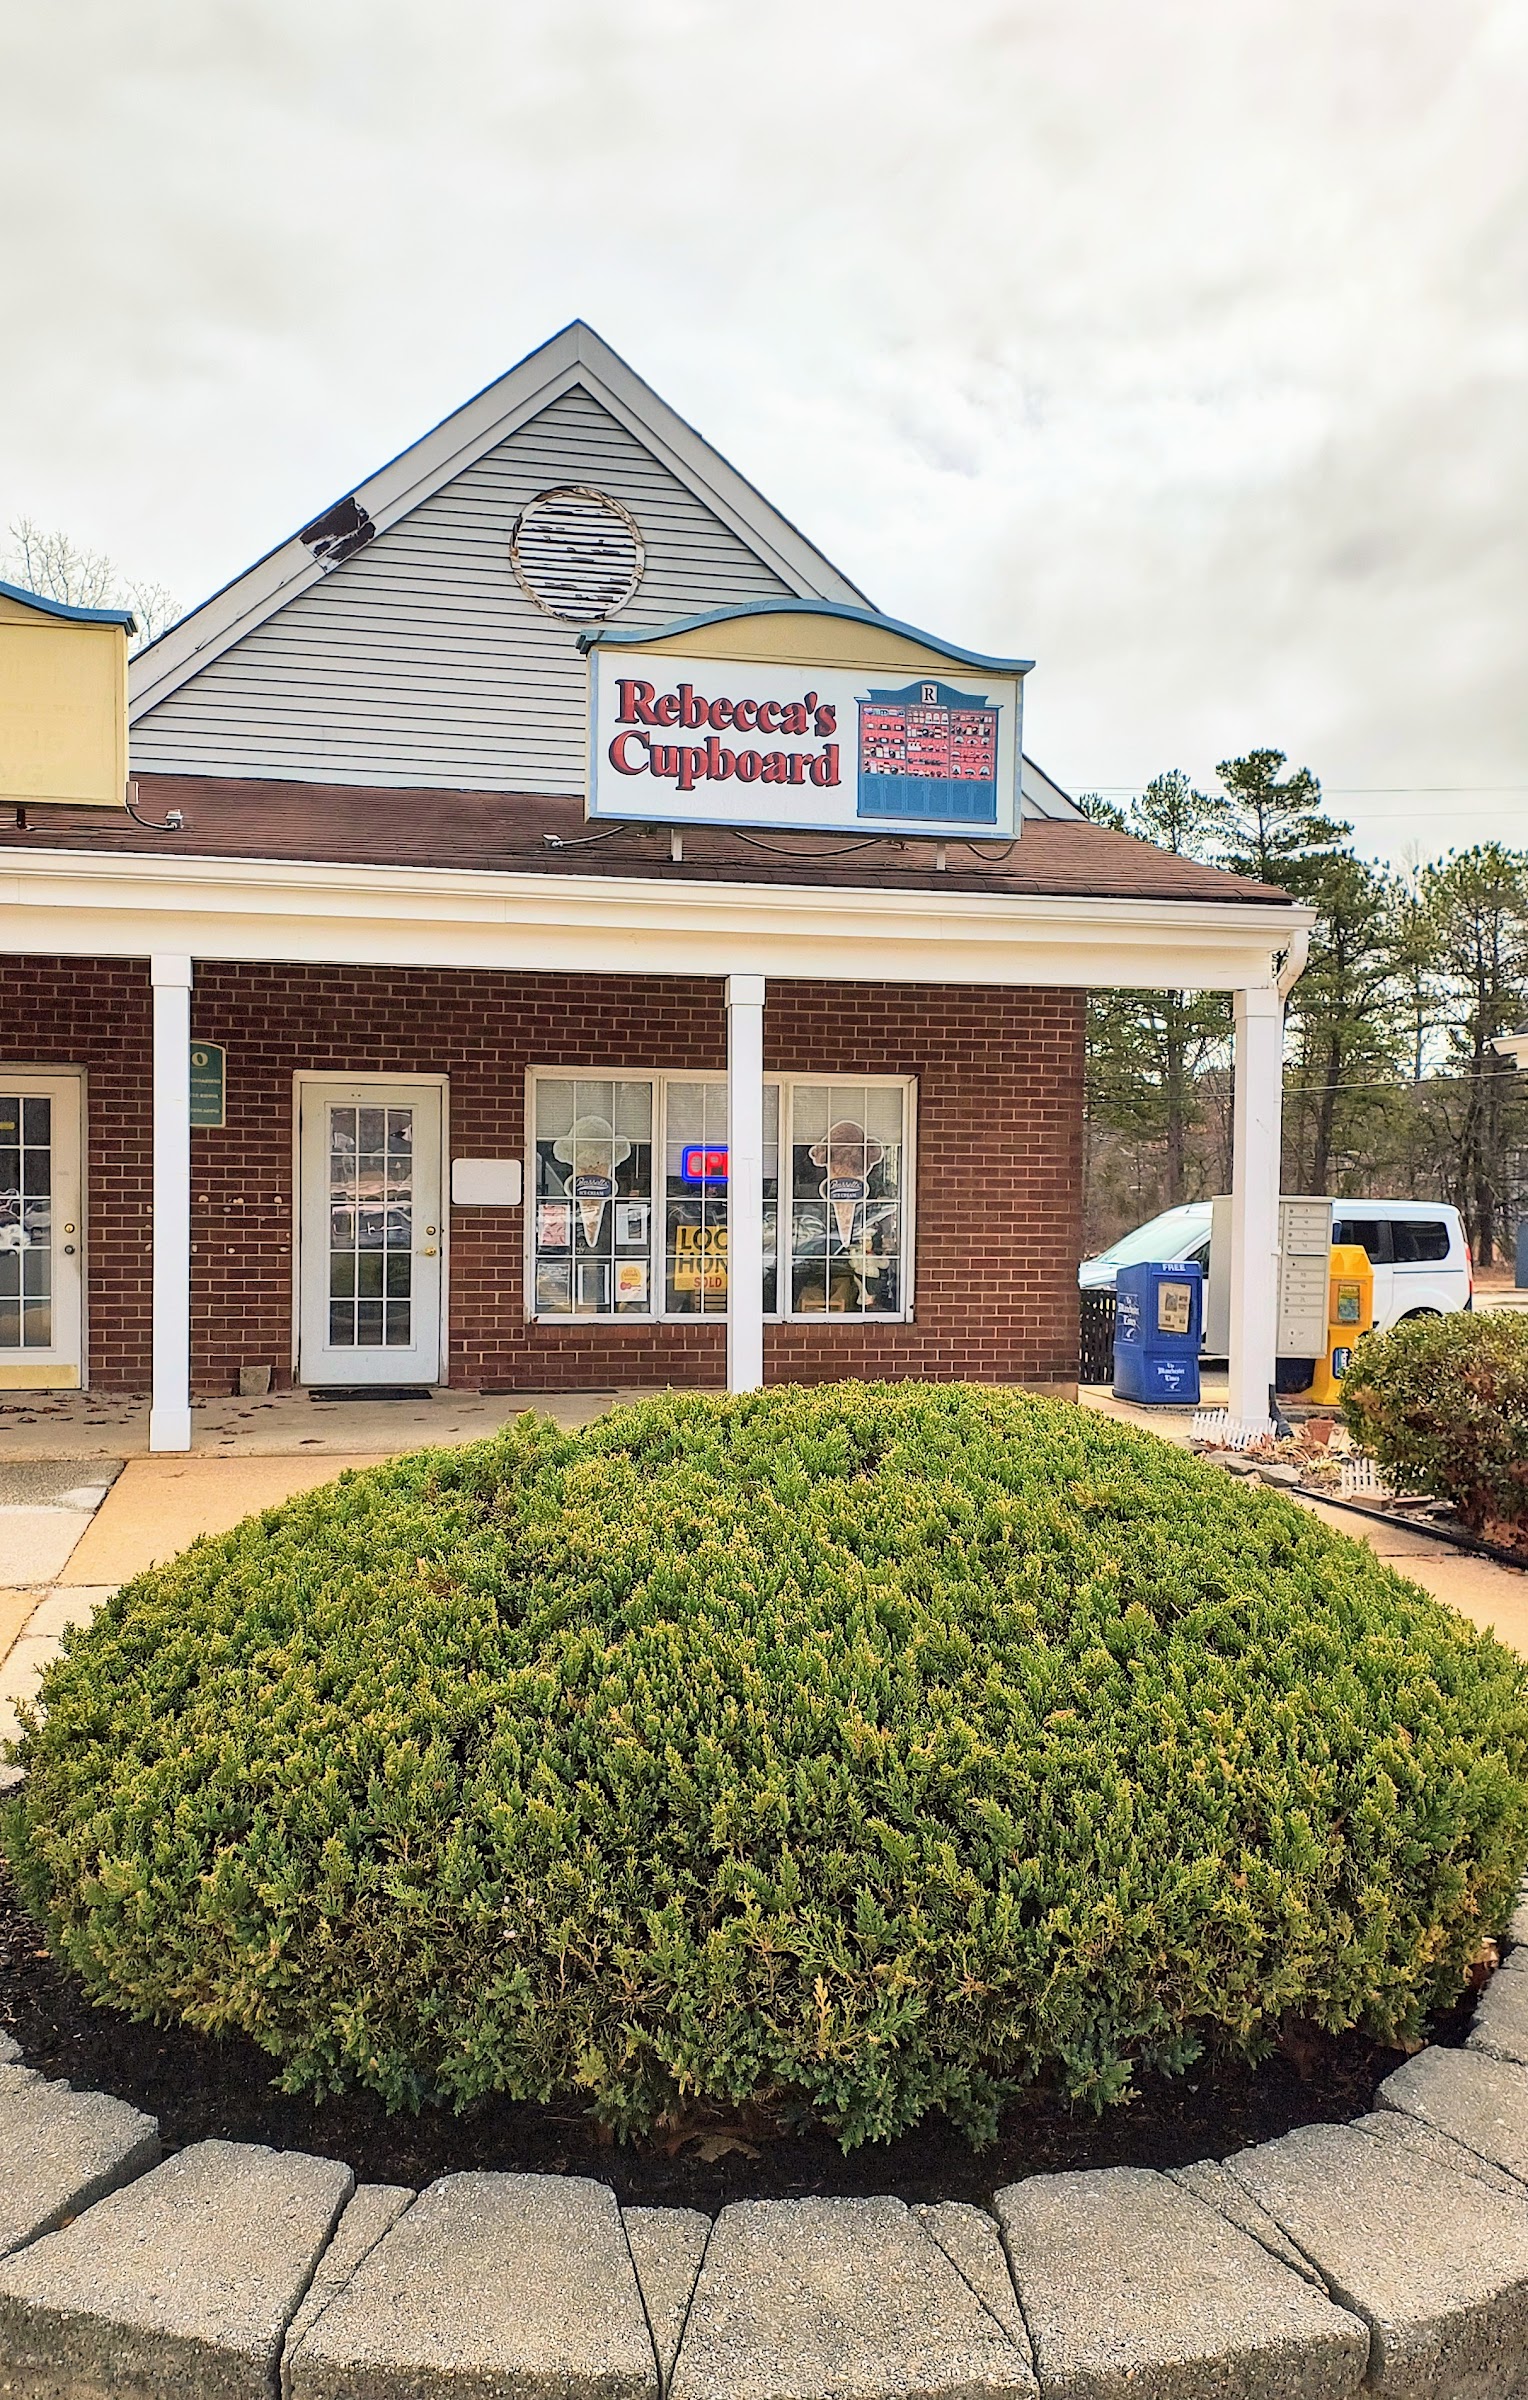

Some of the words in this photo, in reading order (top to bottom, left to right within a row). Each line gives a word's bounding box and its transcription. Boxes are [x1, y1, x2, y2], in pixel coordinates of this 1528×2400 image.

[924, 687, 935, 701] R
[614, 679, 838, 736] Rebecca's
[608, 729, 842, 791] Cupboard
[191, 1052, 208, 1066] O
[687, 1151, 728, 1177] OP
[680, 1227, 728, 1250] LOC
[678, 1252, 728, 1274] HON
[1162, 1263, 1187, 1272] FREE
[693, 1276, 722, 1288] SOLD
